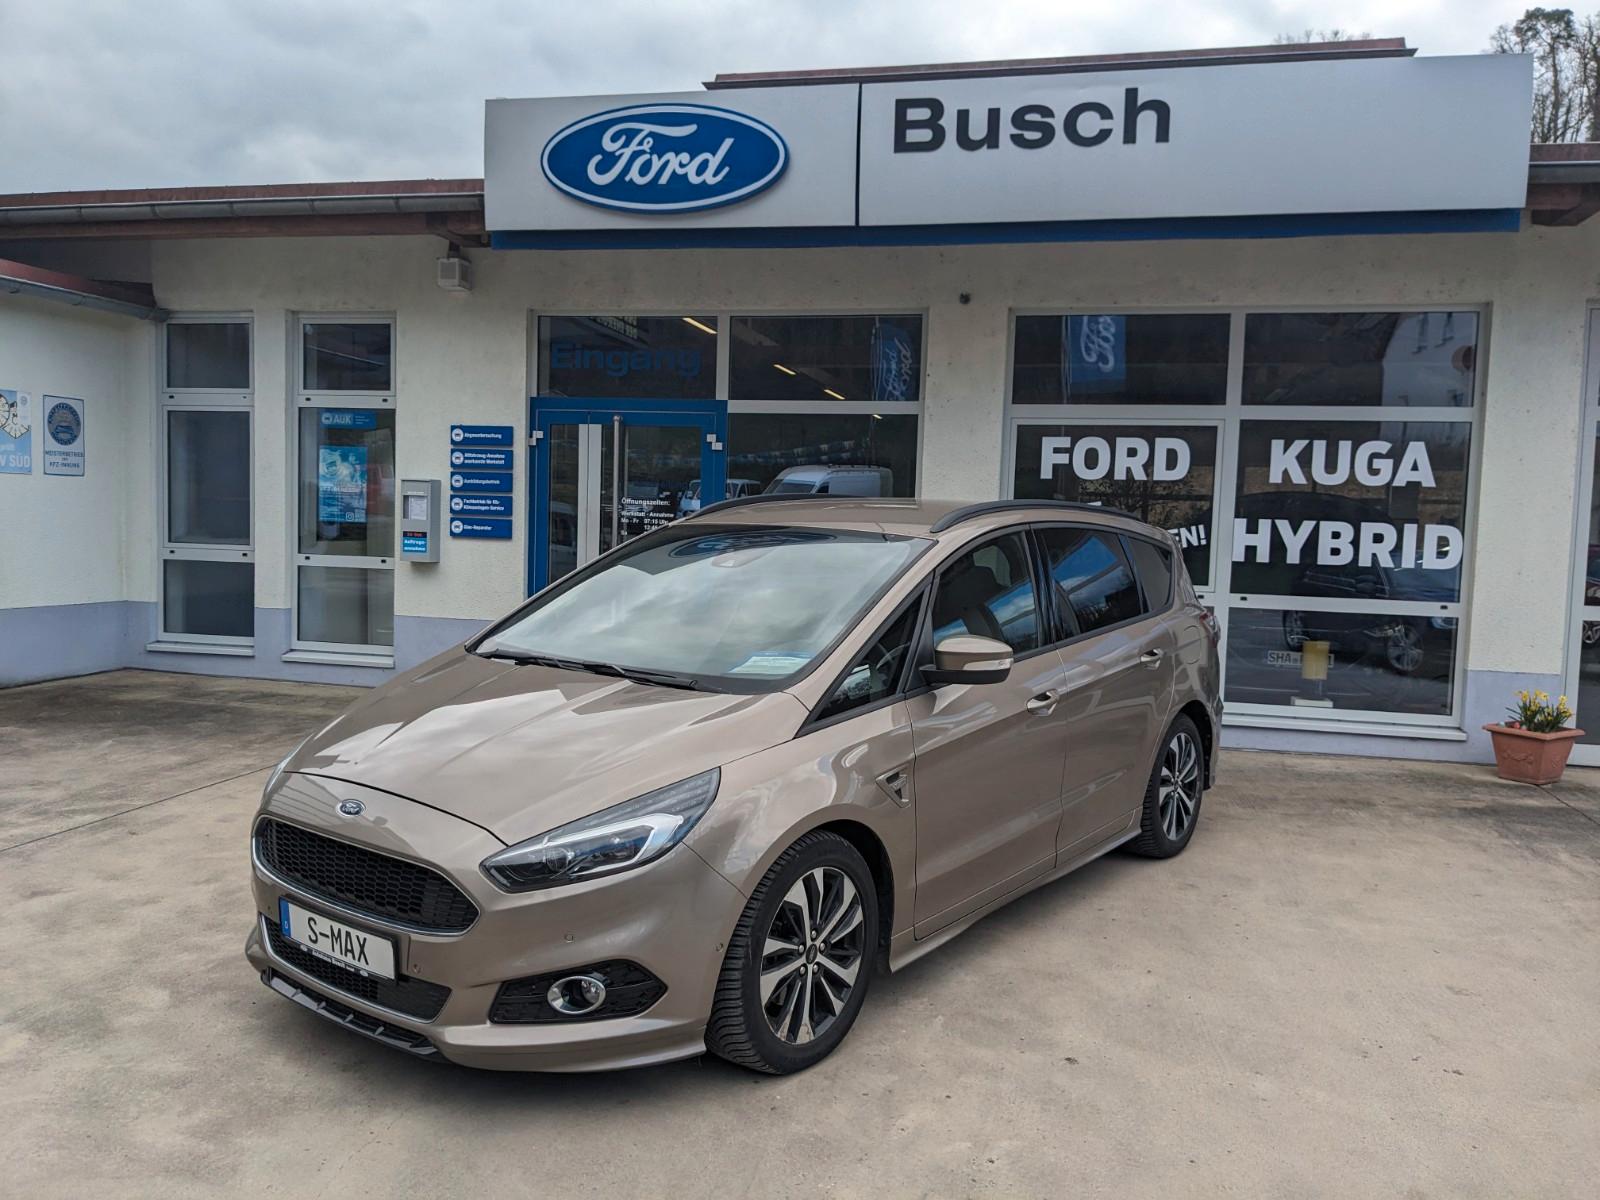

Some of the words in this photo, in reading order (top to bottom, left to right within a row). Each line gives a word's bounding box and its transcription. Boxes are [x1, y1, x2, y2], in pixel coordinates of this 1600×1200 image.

[893, 87, 1171, 153] Busch
[587, 122, 735, 187] Ford
[550, 341, 702, 377] Eingang
[1040, 436, 1191, 481] FORD
[1269, 439, 1436, 488] KUGA
[621, 497, 671, 507] Öffnungszeiten:
[1232, 517, 1464, 570] HYBRID
[1268, 651, 1291, 665] SHA
[307, 916, 369, 966] S-MAX
